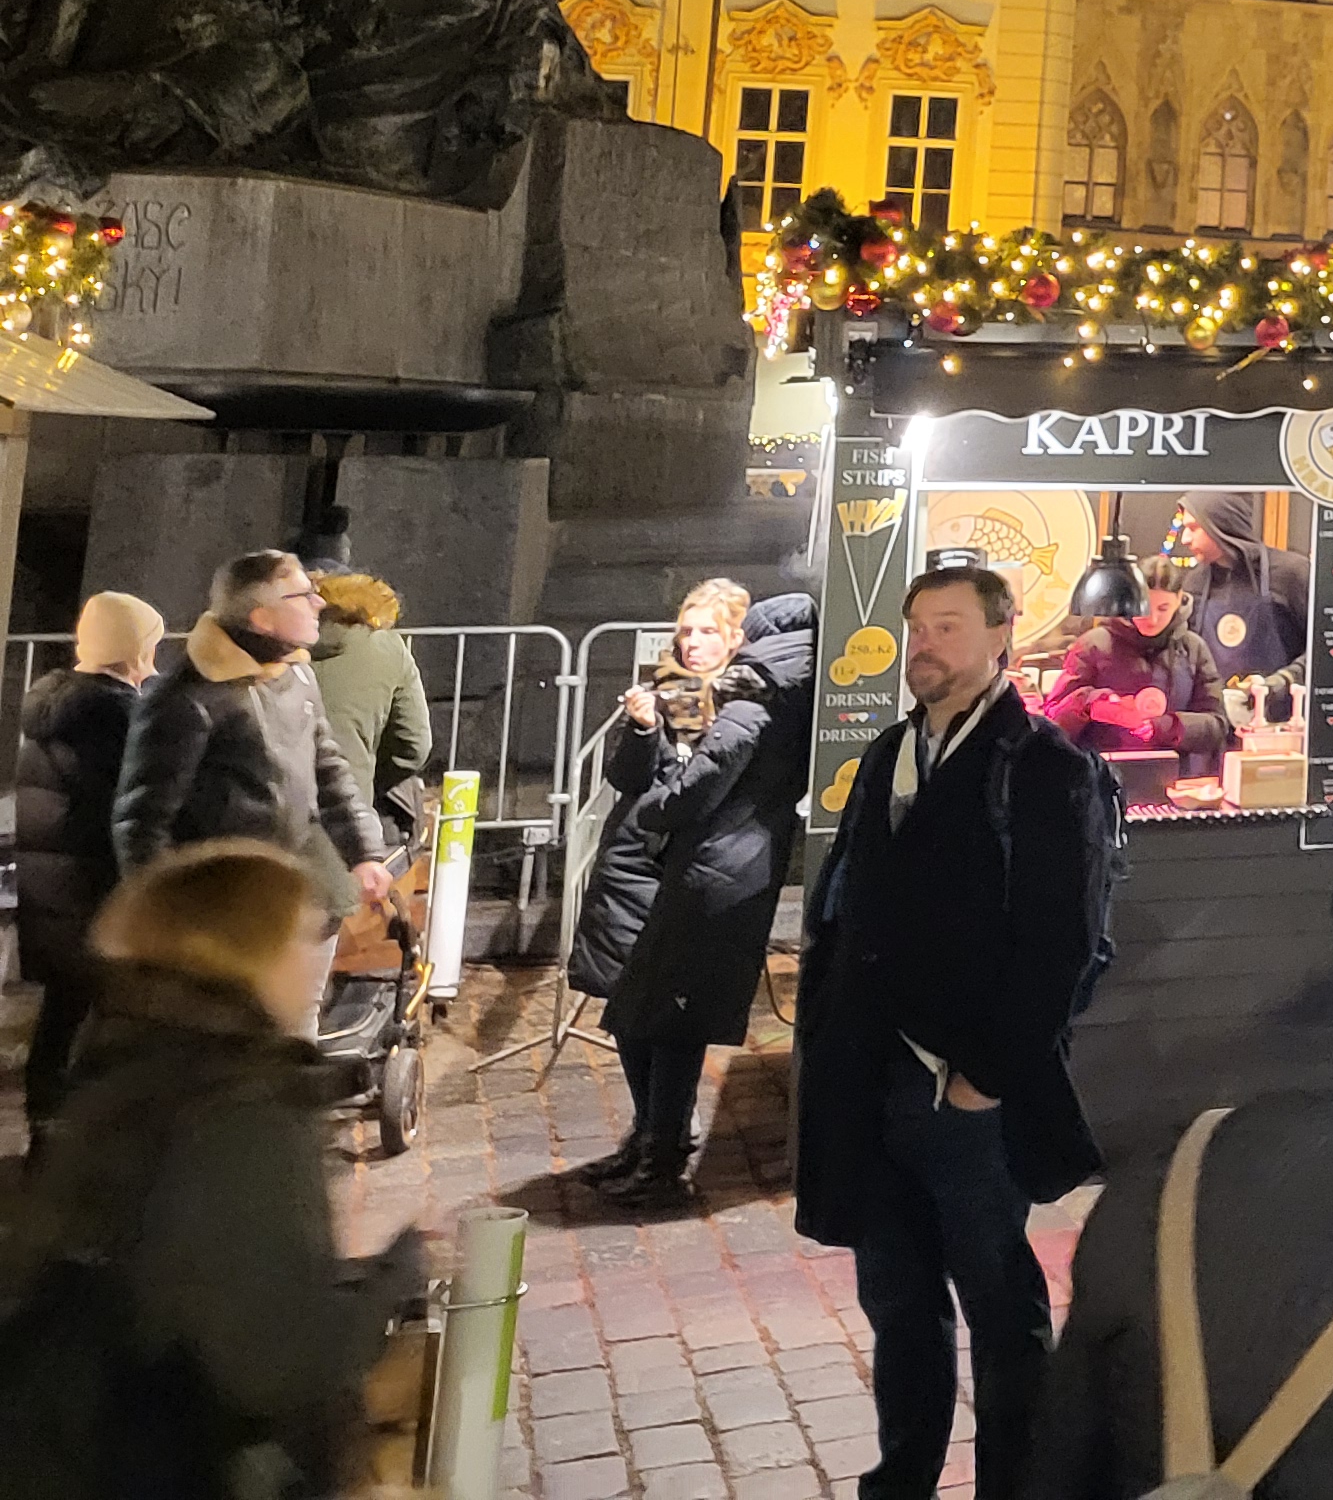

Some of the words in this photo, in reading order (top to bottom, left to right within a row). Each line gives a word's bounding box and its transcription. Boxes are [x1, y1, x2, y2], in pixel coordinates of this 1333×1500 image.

[851, 448, 894, 466] FISH
[841, 468, 906, 487] STRIPS
[825, 692, 893, 708] DRESINK
[819, 728, 882, 743] DRESSIN
